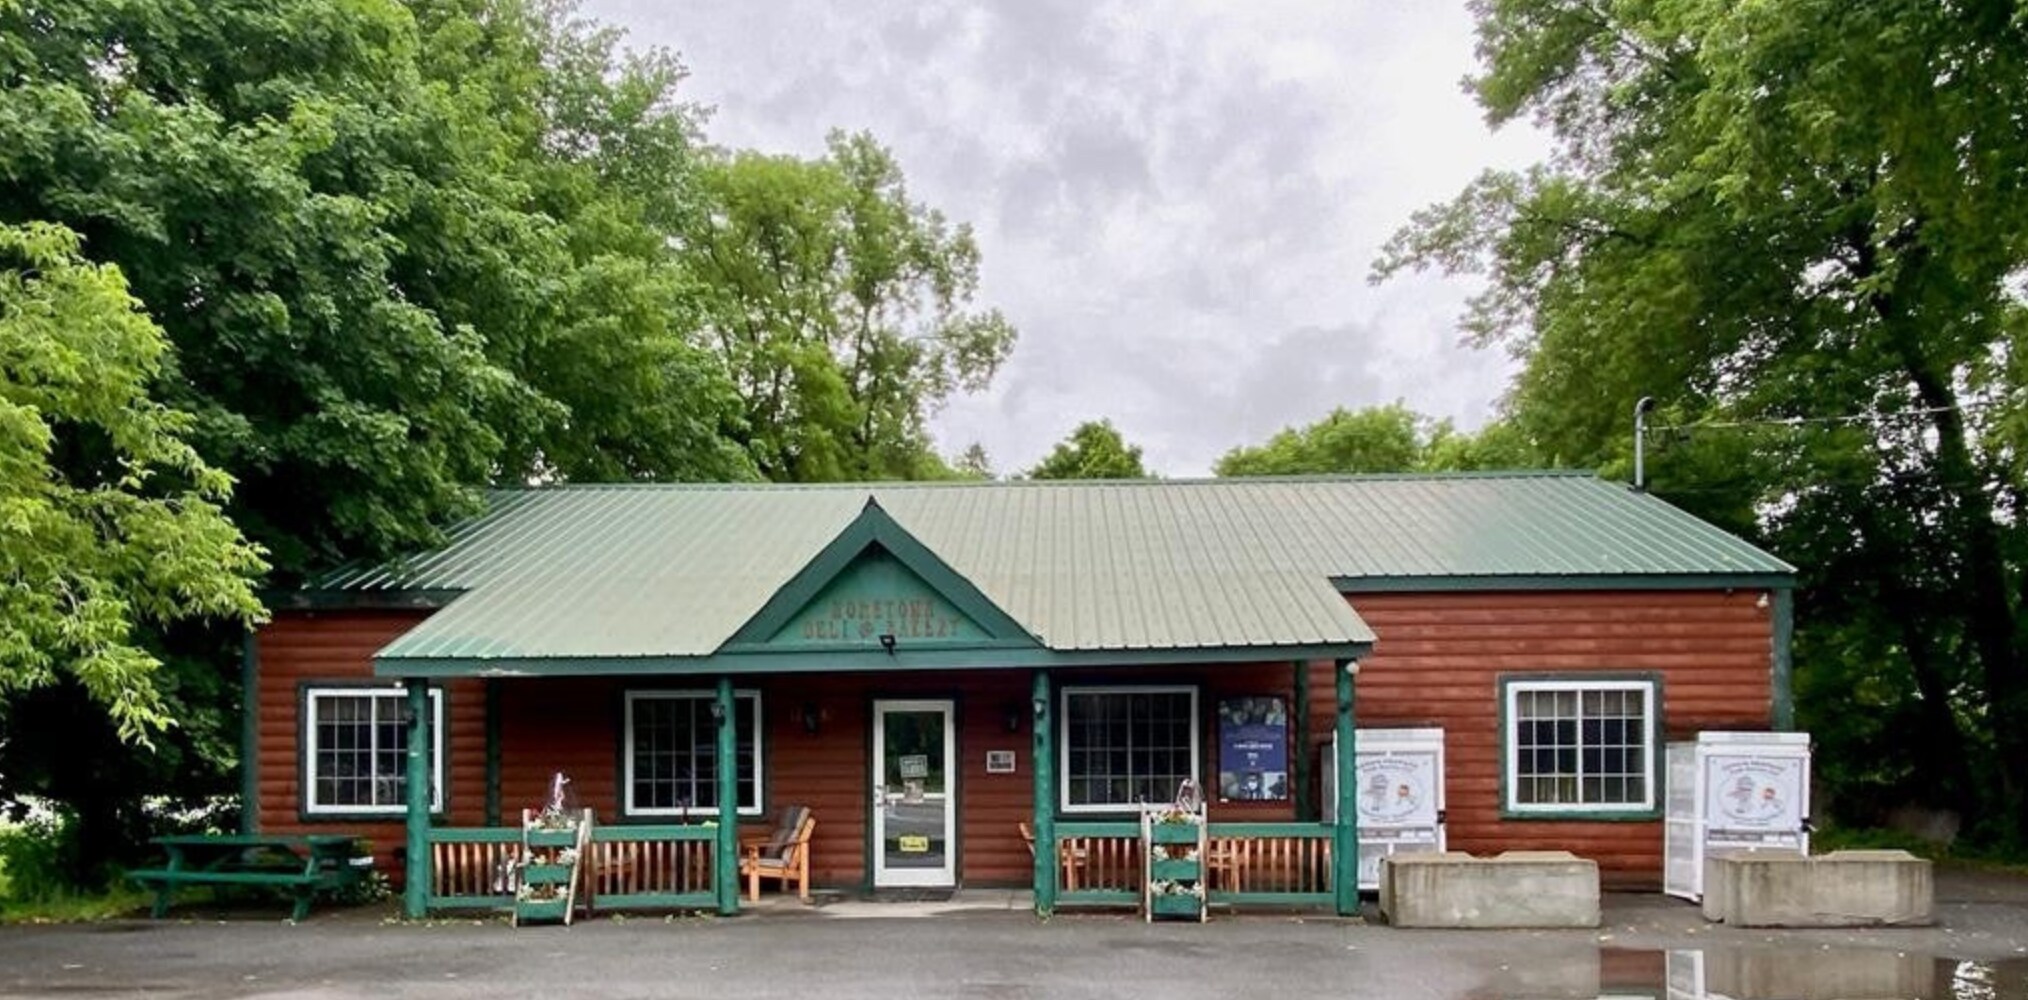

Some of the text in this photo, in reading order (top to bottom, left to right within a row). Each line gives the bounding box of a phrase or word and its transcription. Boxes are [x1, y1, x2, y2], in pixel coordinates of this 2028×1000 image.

[831, 601, 935, 619] HOMETOWN
[804, 620, 849, 639] DELI
[886, 616, 962, 638] BAKERY
